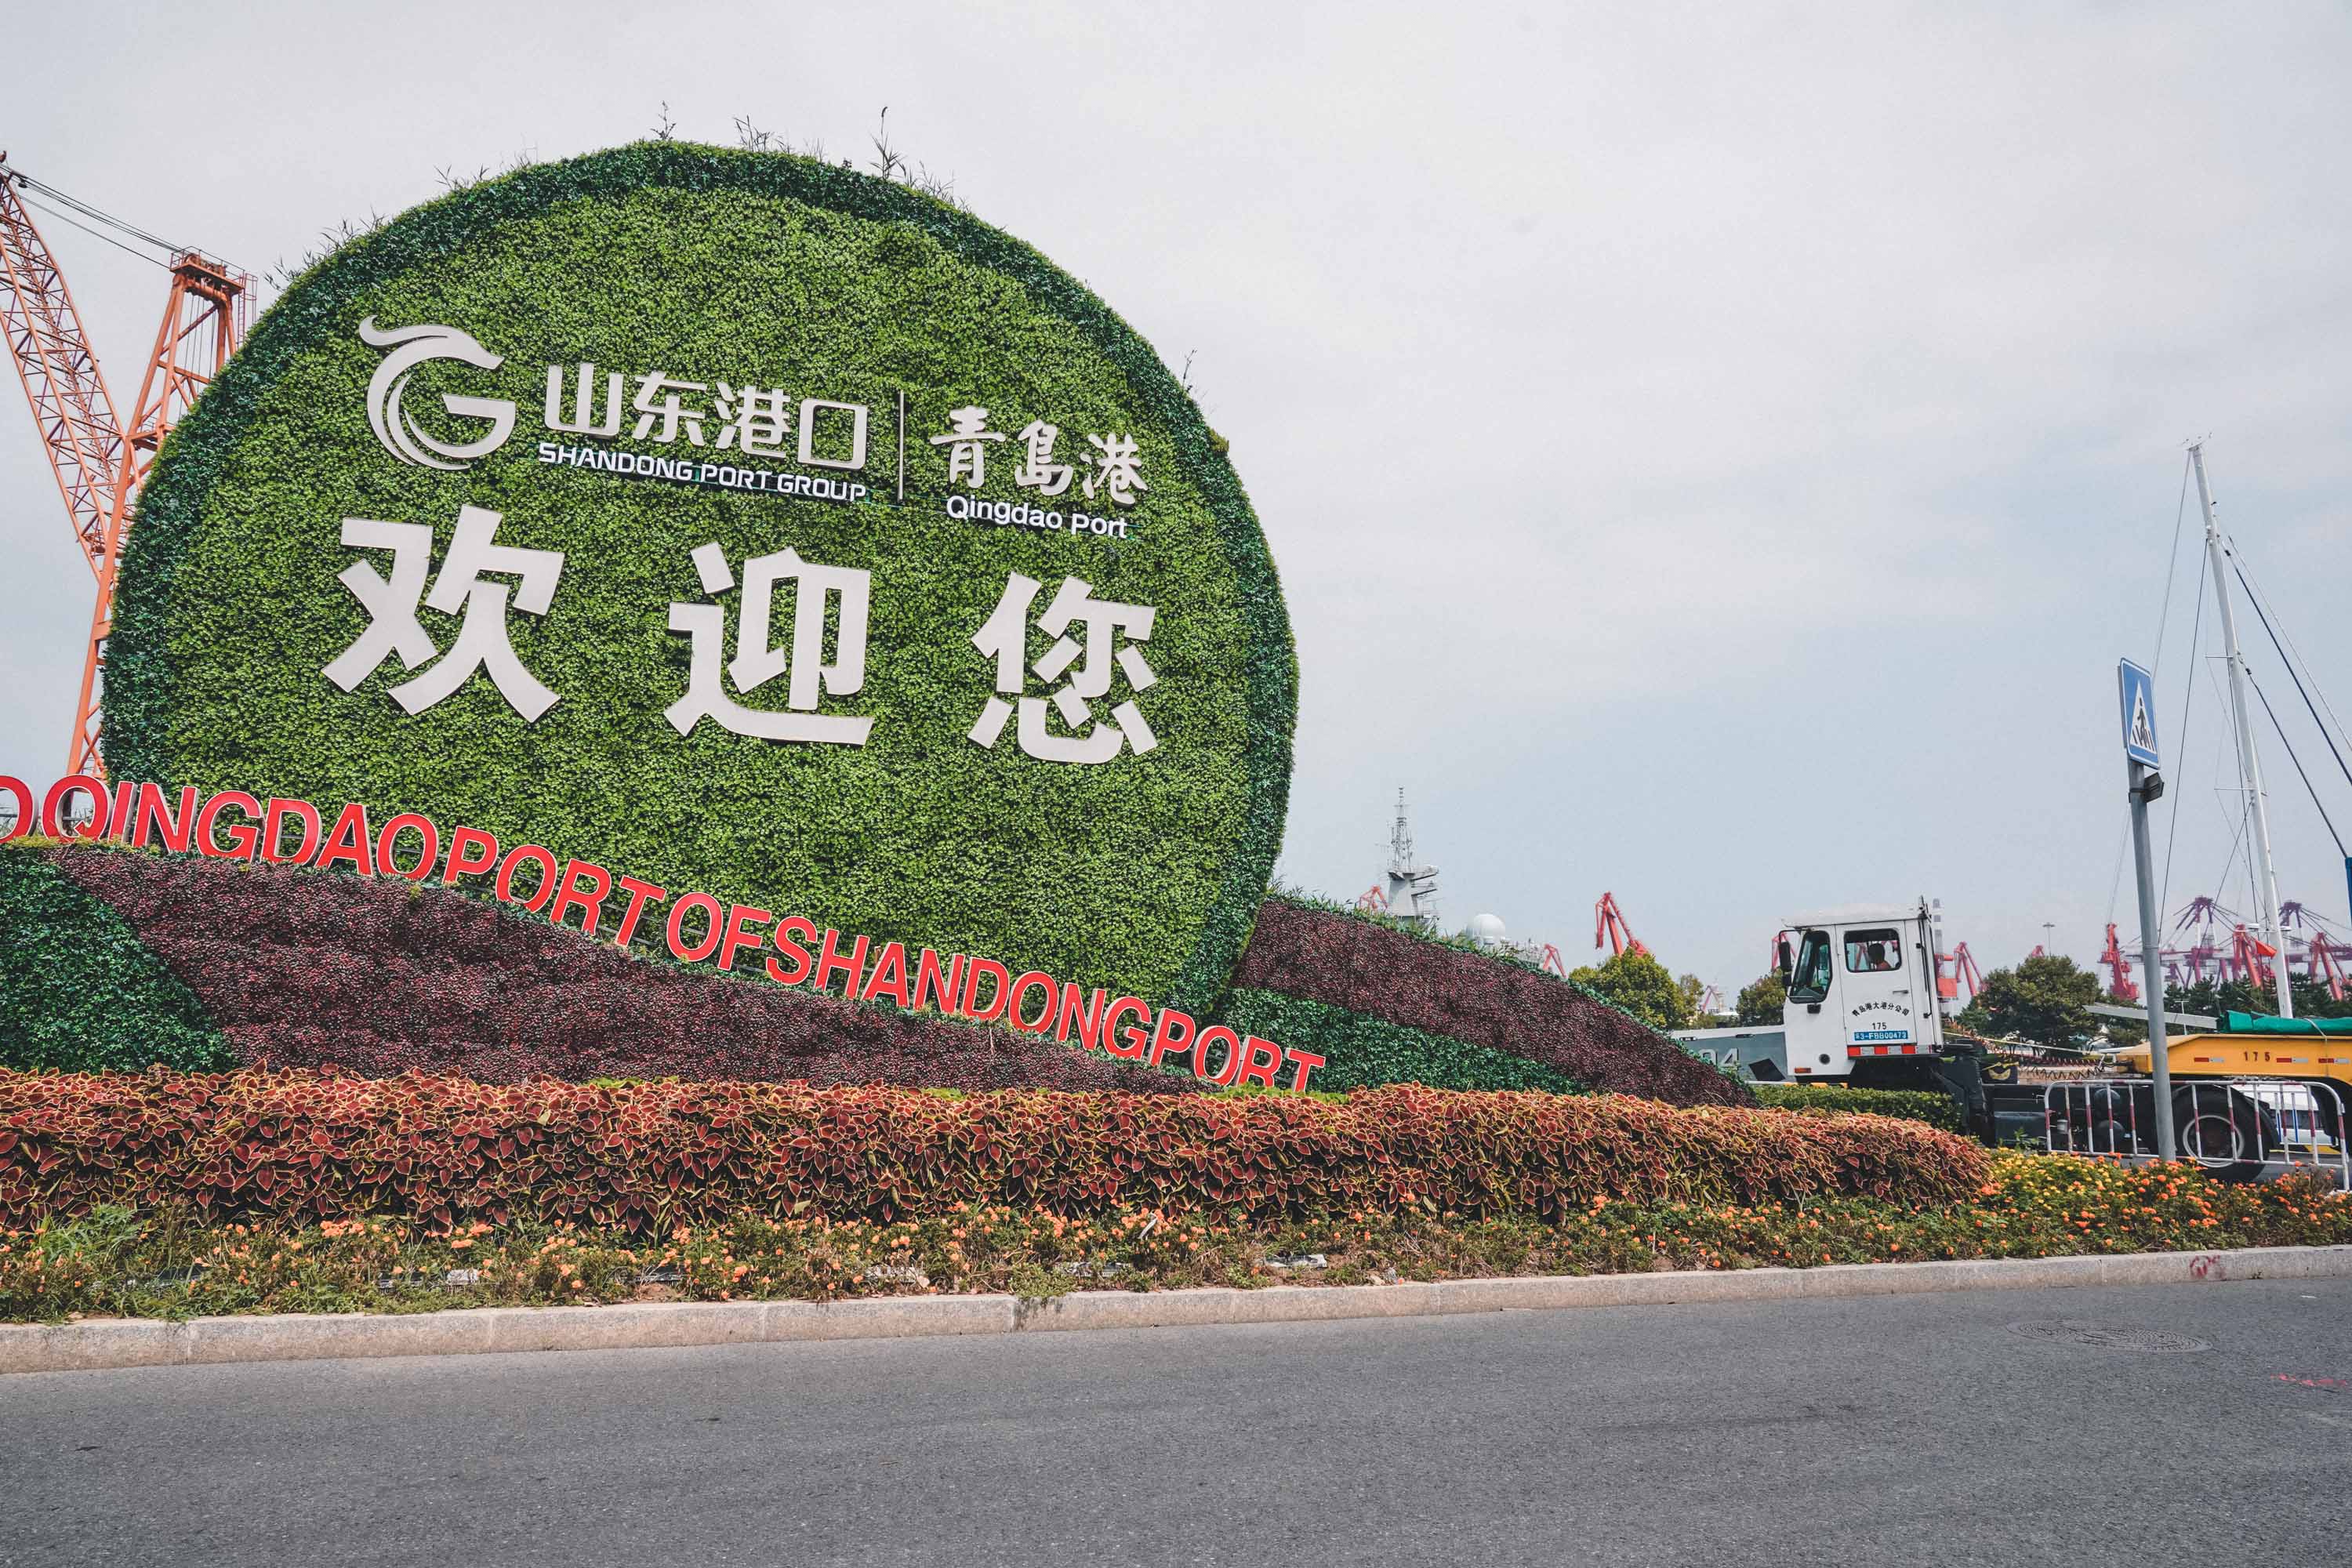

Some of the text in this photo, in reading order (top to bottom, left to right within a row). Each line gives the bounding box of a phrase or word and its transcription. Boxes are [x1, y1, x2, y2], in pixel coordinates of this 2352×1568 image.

[545, 362, 868, 470] 山东港口
[930, 405, 1148, 506] 青島港
[539, 442, 866, 503] SHANDONG PORT GROUP
[946, 495, 1127, 539] Qingdao Port
[321, 503, 1157, 765] 欢迎您
[2243, 1051, 2270, 1062] 175
